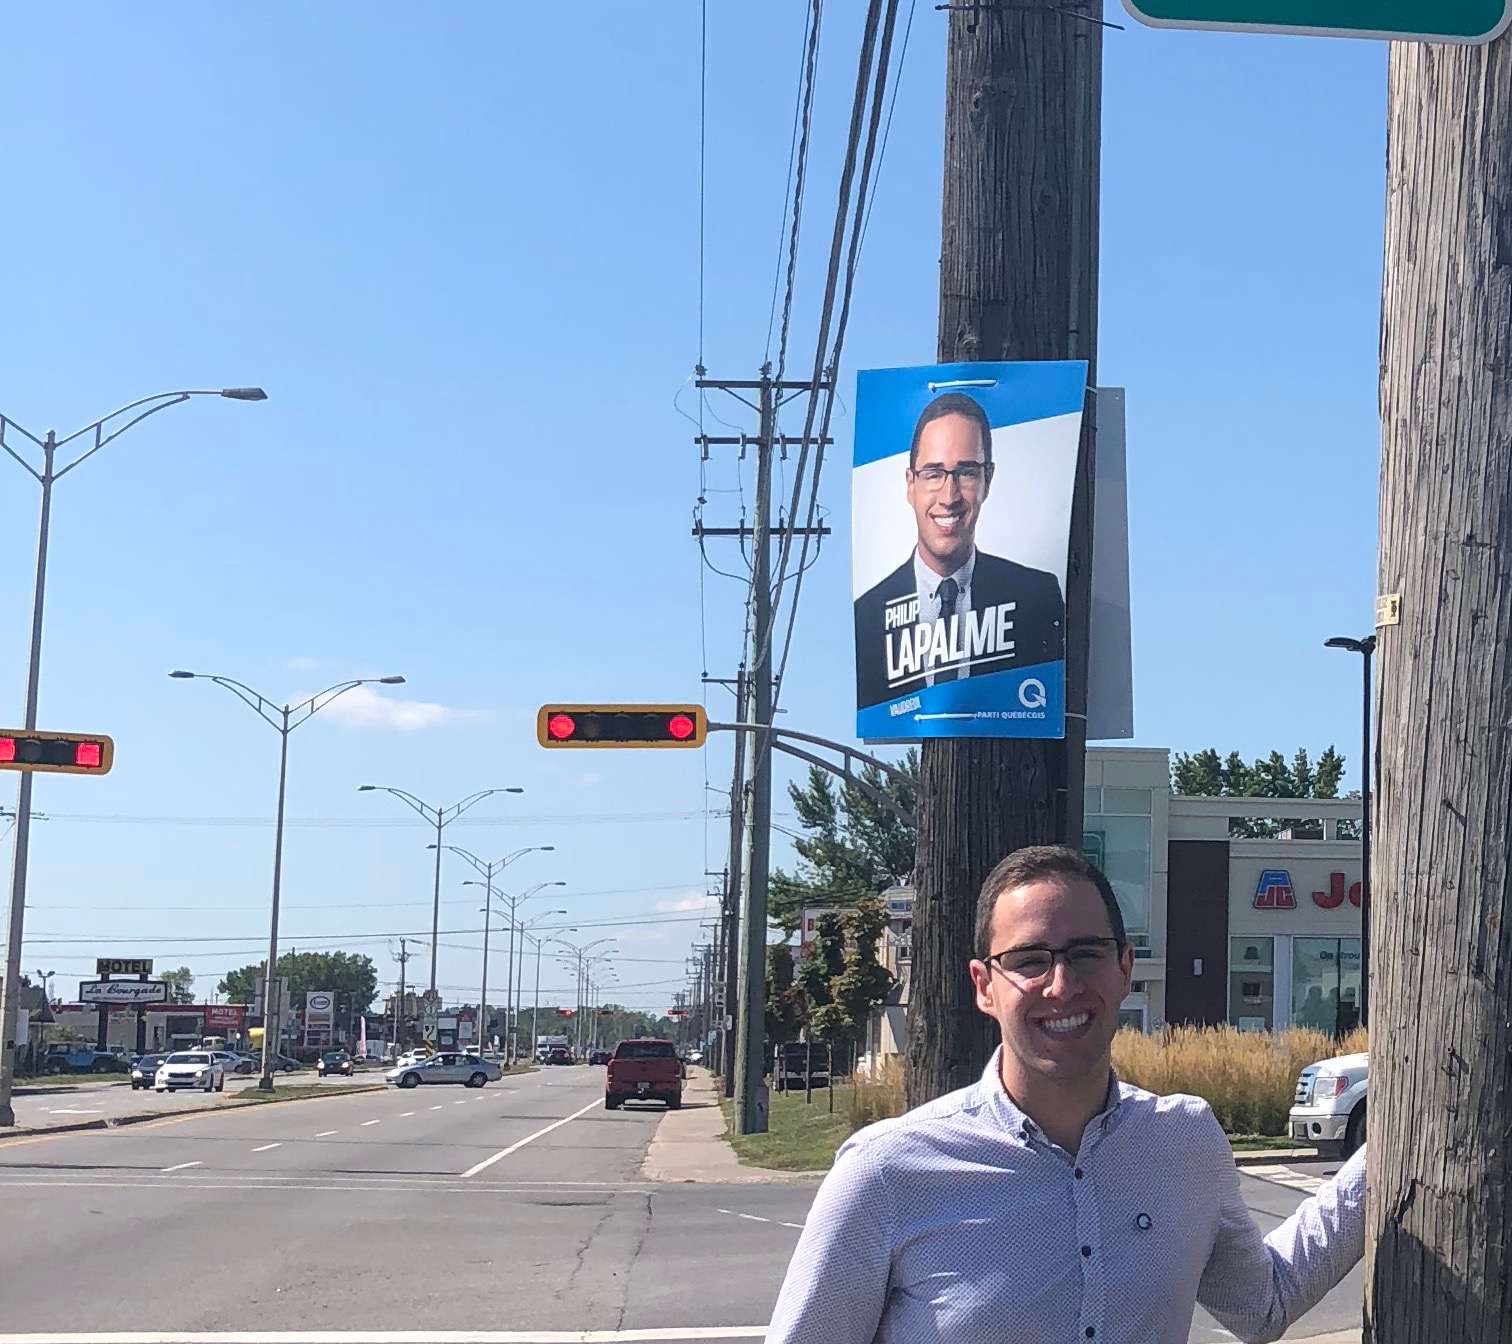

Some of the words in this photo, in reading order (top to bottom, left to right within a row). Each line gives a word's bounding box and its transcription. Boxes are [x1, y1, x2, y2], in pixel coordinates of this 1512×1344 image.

[885, 600, 920, 630] PHILIP
[886, 602, 1016, 681] LAPALME
[978, 711, 1000, 719] PARTI
[100, 960, 149, 973] MOTEL
[85, 983, 102, 994] La
[106, 983, 162, 998] Bourgade
[211, 1007, 238, 1016] MOTEL
